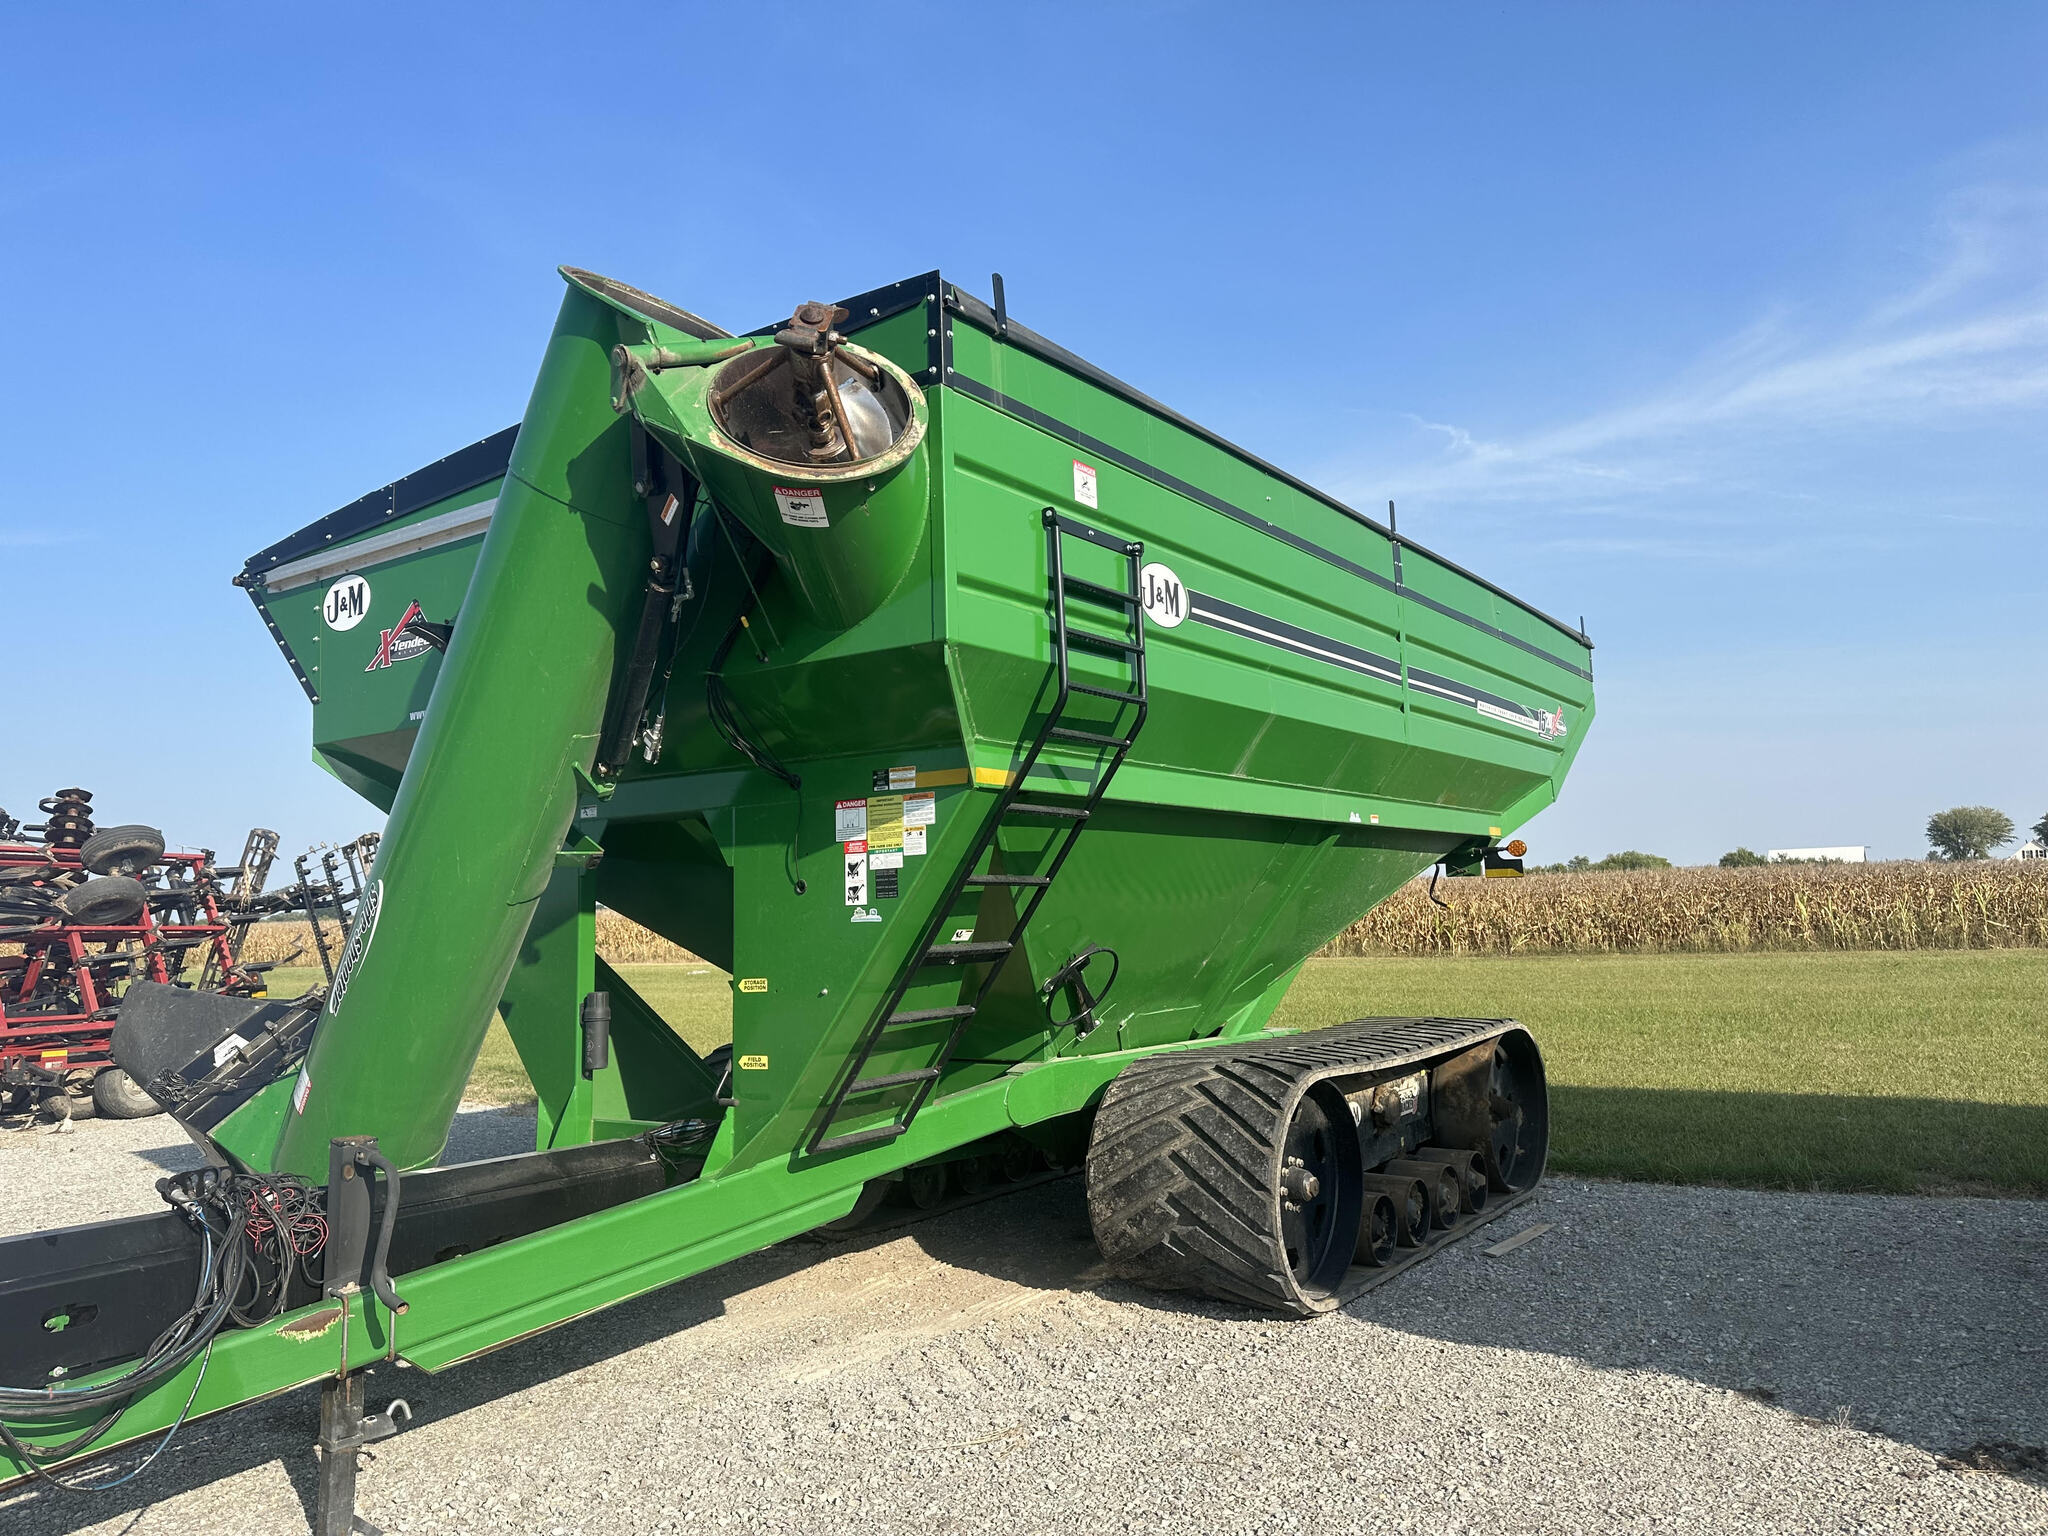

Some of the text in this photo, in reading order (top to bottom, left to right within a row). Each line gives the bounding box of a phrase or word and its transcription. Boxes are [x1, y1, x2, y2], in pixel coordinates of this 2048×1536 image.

[781, 488, 821, 497] DANGER
[326, 582, 364, 624] J&M
[1141, 574, 1180, 618] J&M
[842, 799, 866, 808] DANGER
